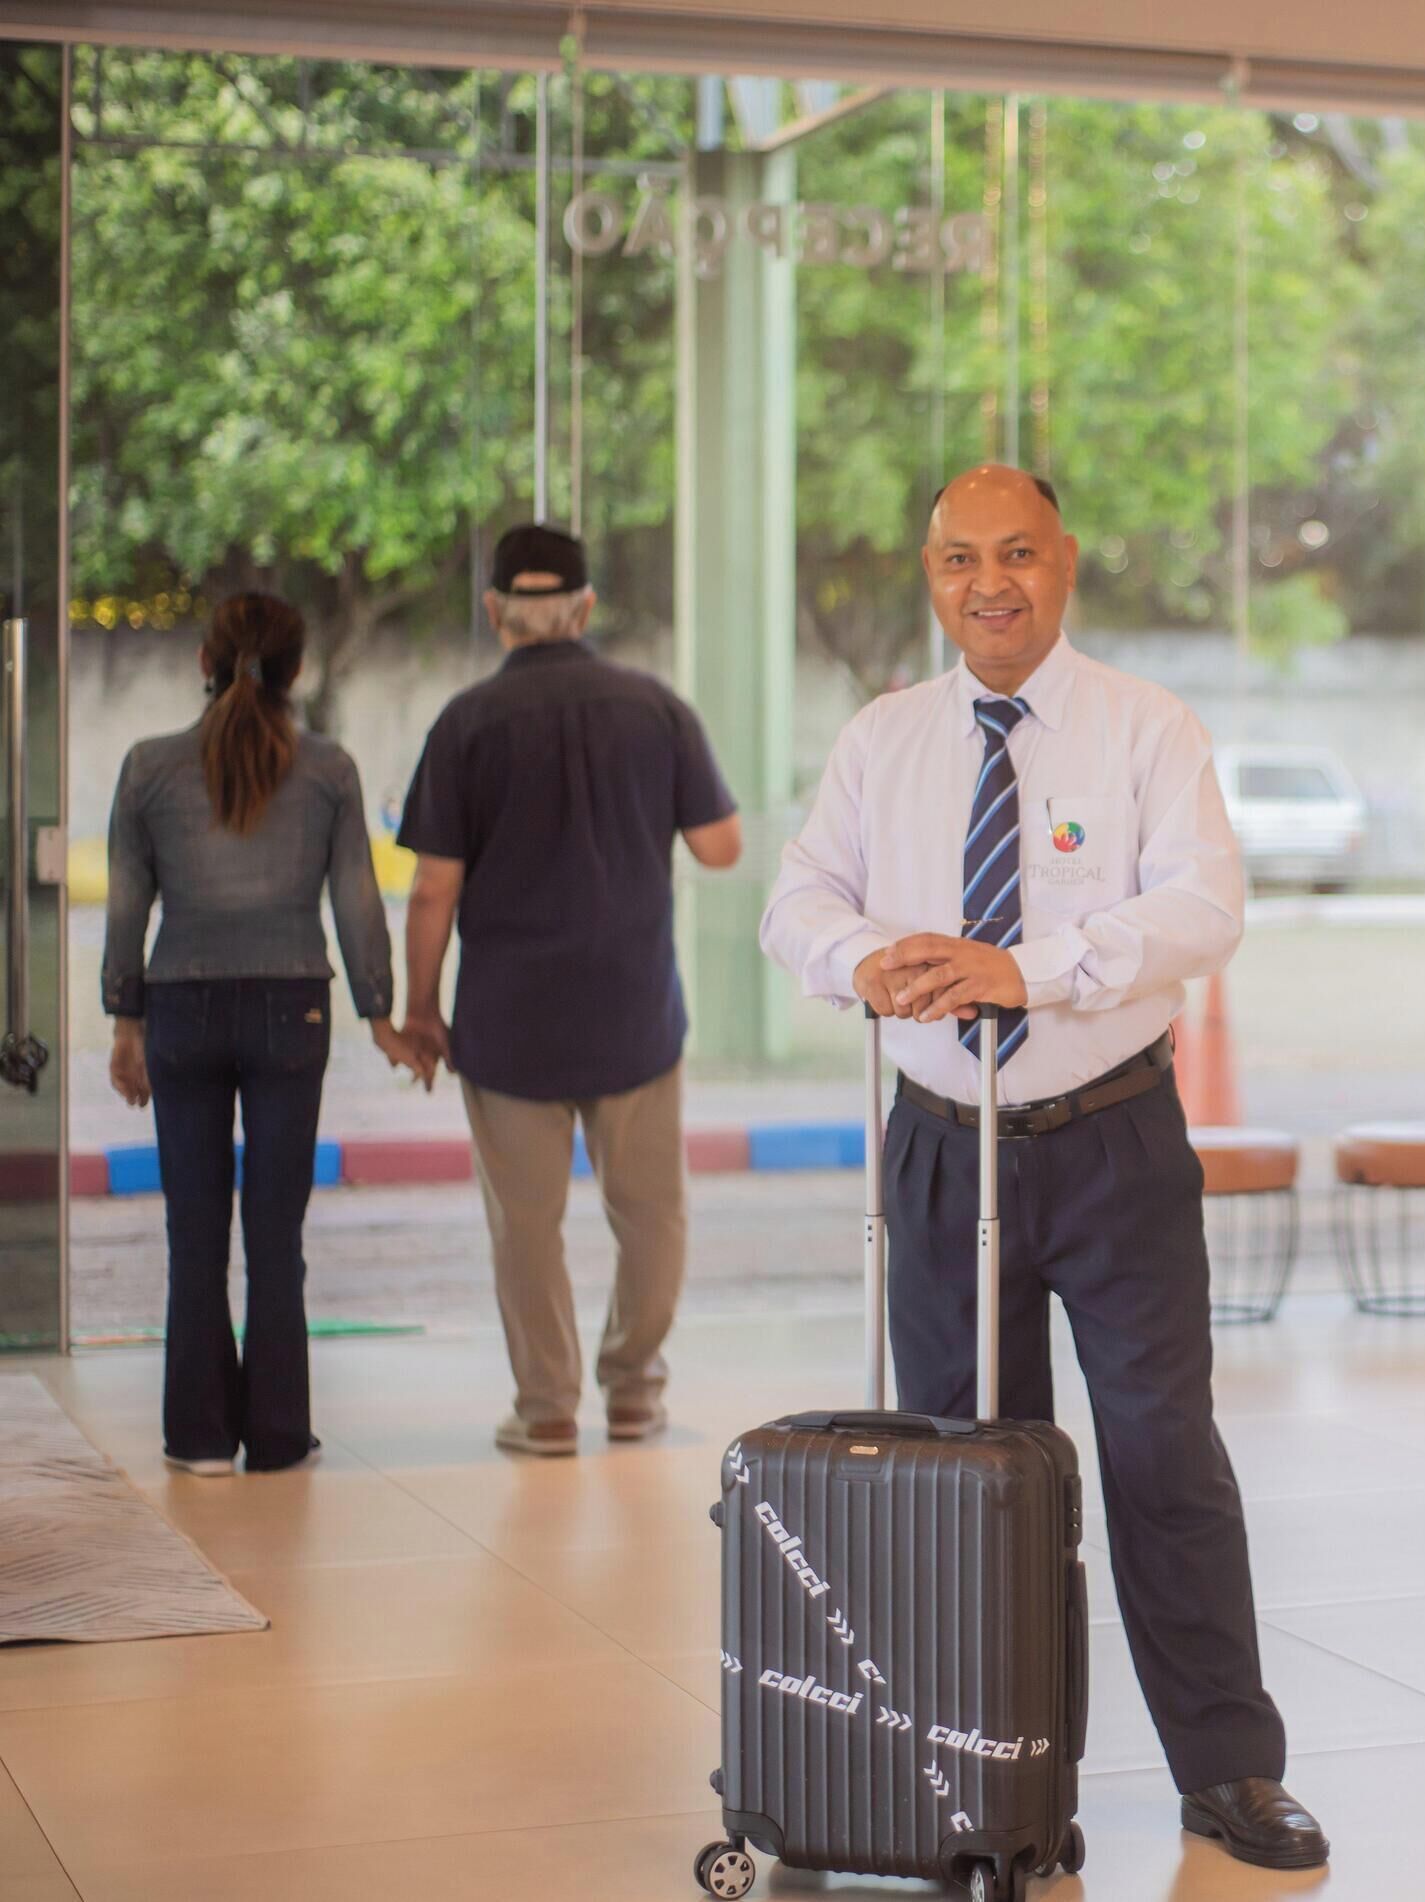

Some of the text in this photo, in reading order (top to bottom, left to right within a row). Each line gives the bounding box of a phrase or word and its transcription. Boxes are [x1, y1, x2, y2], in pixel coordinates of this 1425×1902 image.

[1028, 864, 1107, 882] TROPICAL
[755, 1501, 831, 1599] colcci
[758, 1669, 1024, 1760] colcci colcci
